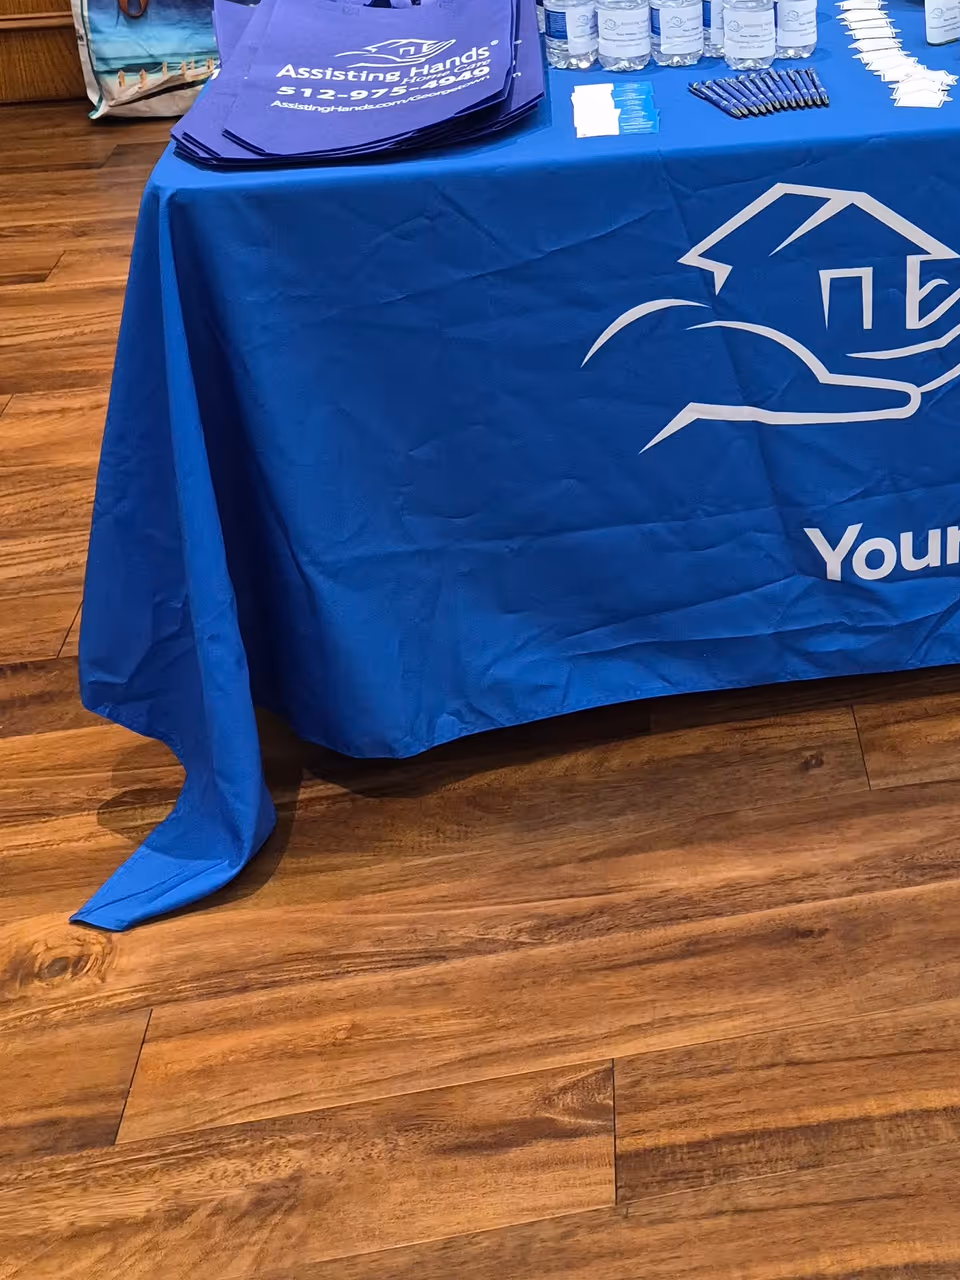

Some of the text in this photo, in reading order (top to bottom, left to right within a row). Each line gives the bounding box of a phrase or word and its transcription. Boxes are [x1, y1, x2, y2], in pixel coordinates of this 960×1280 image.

[276, 63, 400, 83] Assisting
[276, 66, 490, 101] 512-975-4949
[400, 59, 491, 85] Home Care
